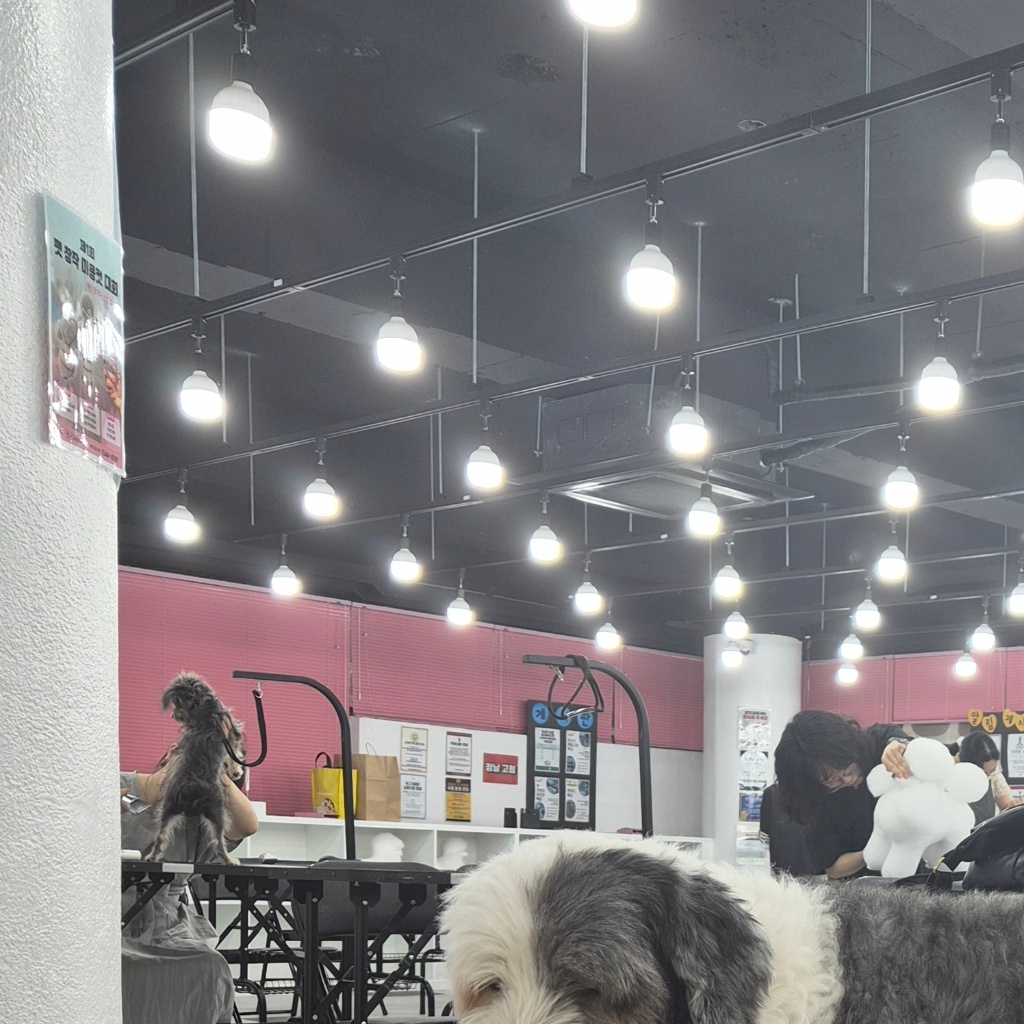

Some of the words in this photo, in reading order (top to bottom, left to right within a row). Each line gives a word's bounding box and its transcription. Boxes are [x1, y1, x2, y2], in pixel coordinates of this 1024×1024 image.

[79, 238, 95, 261] 제1회
[53, 237, 63, 258] 펫
[63, 245, 80, 270] 창작
[81, 257, 103, 288] 미용컷
[104, 273, 119, 298] 대회
[971, 711, 994, 731] 알림
